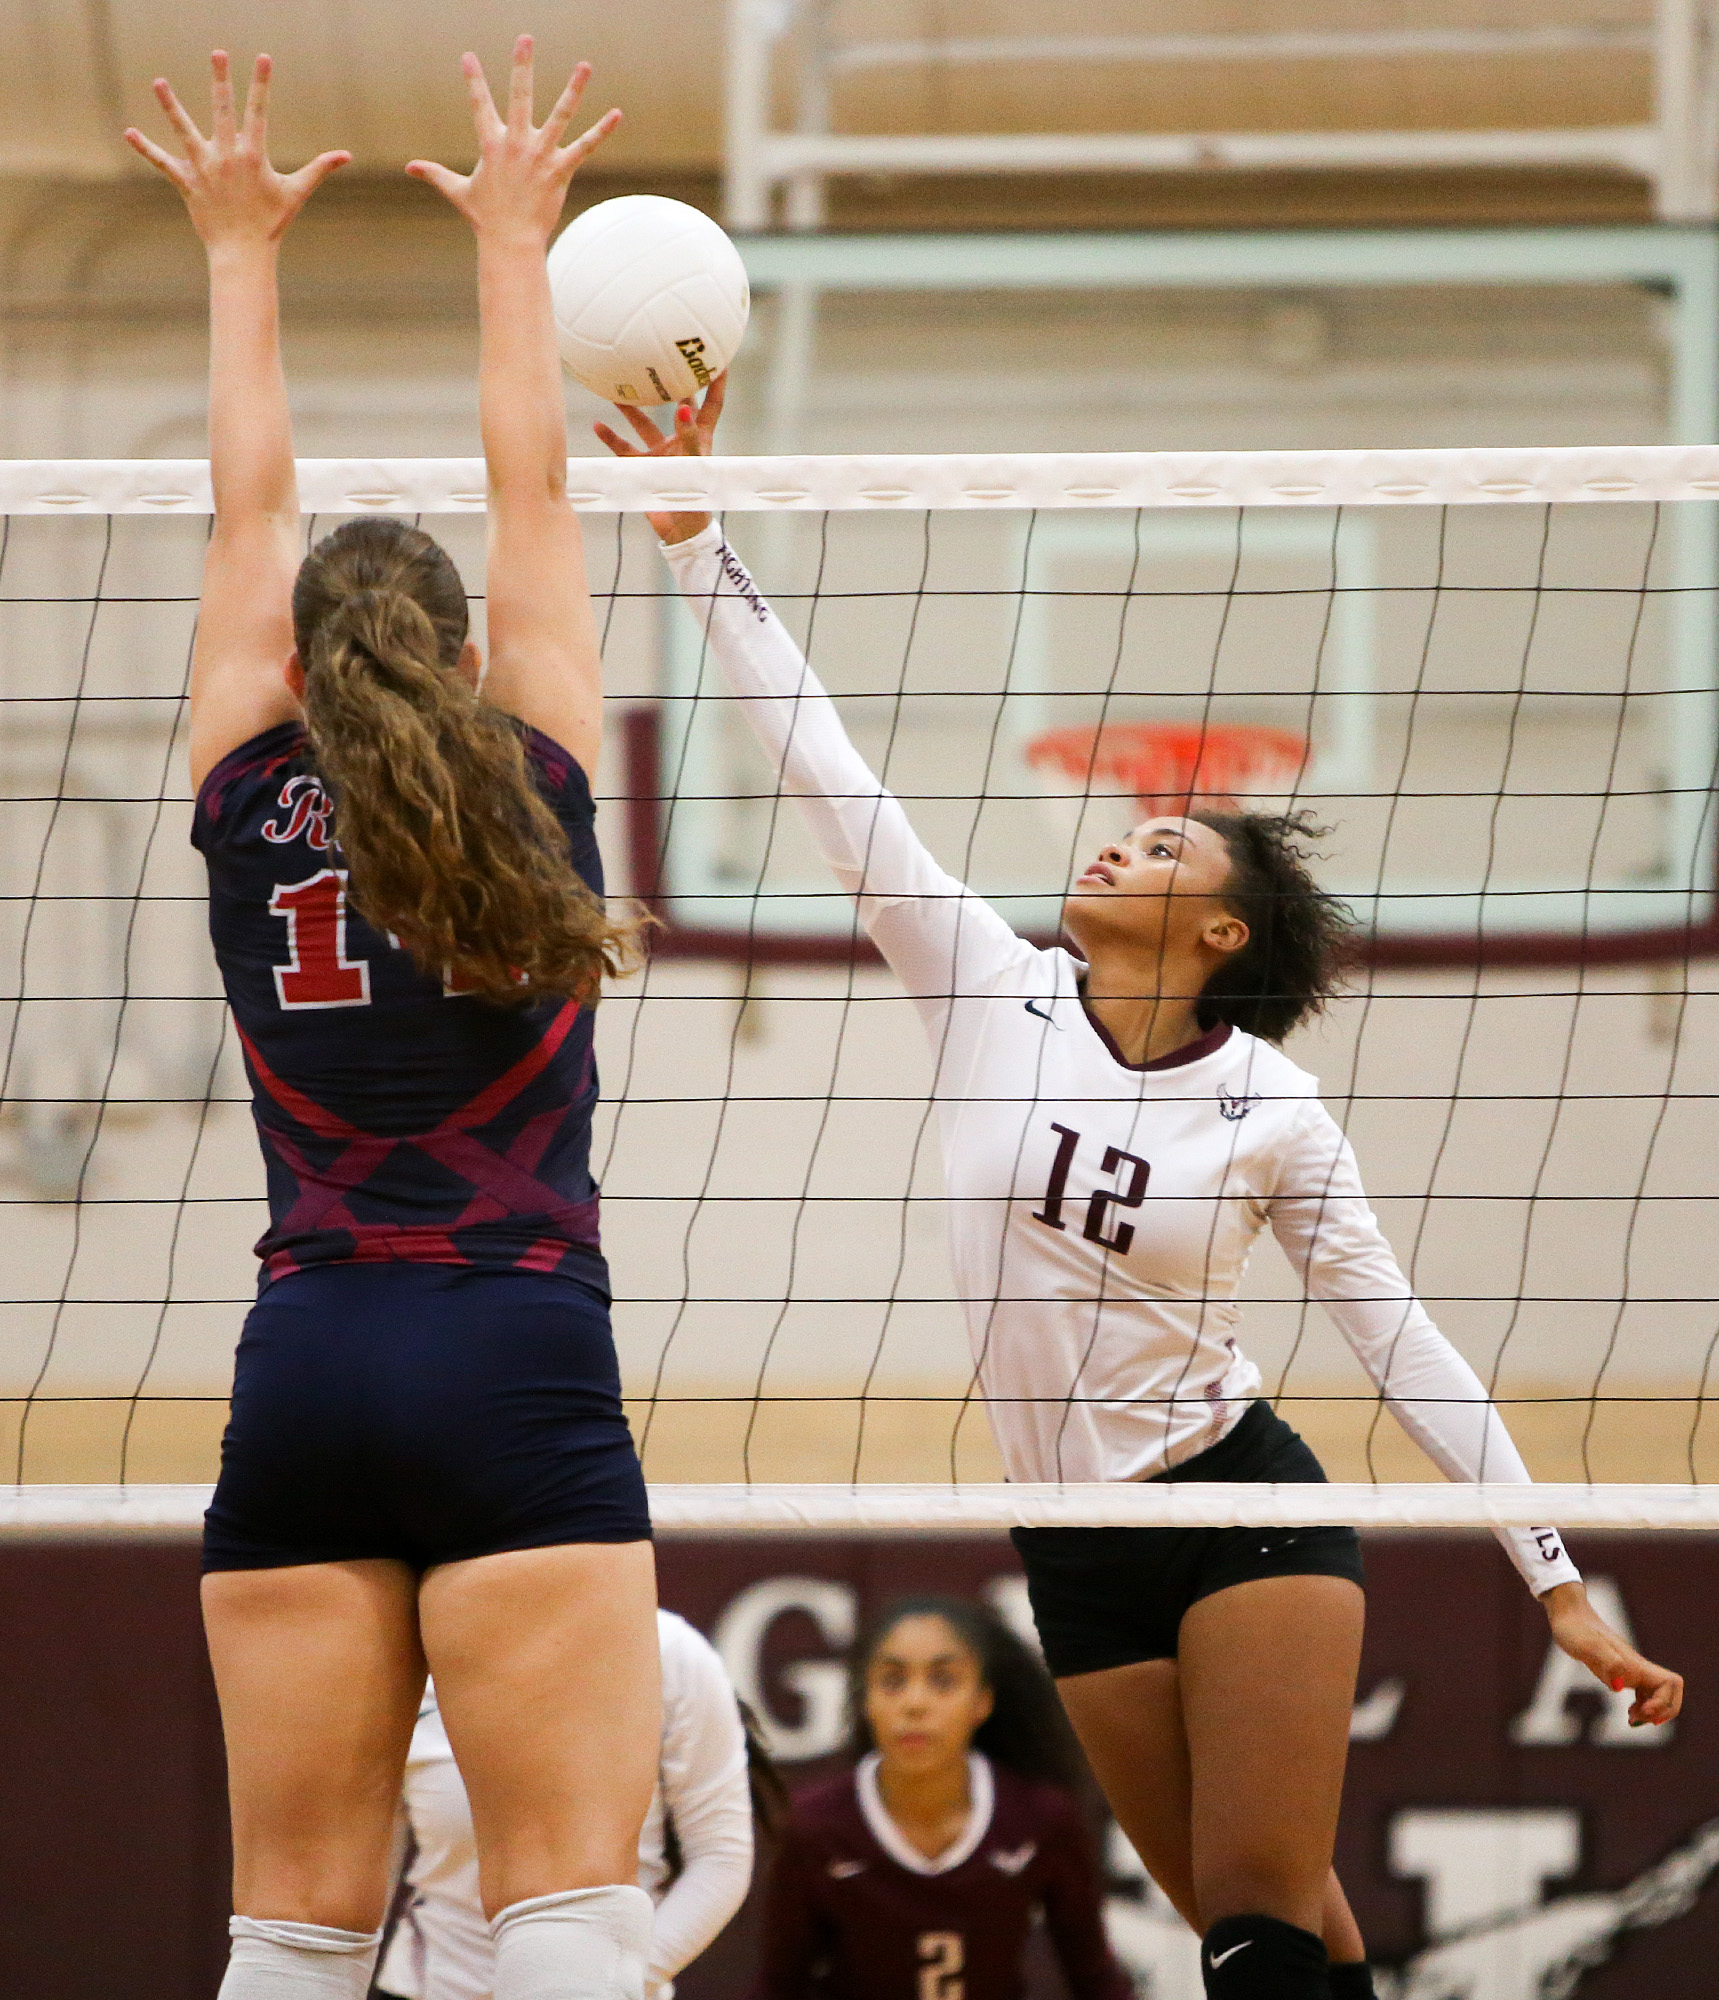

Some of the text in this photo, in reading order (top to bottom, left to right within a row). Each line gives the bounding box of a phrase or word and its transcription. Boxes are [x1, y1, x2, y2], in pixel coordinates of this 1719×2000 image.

[1032, 1121, 1151, 1256] 12
[1530, 1527, 1561, 1562] LS
[915, 1929, 964, 2000] 2
